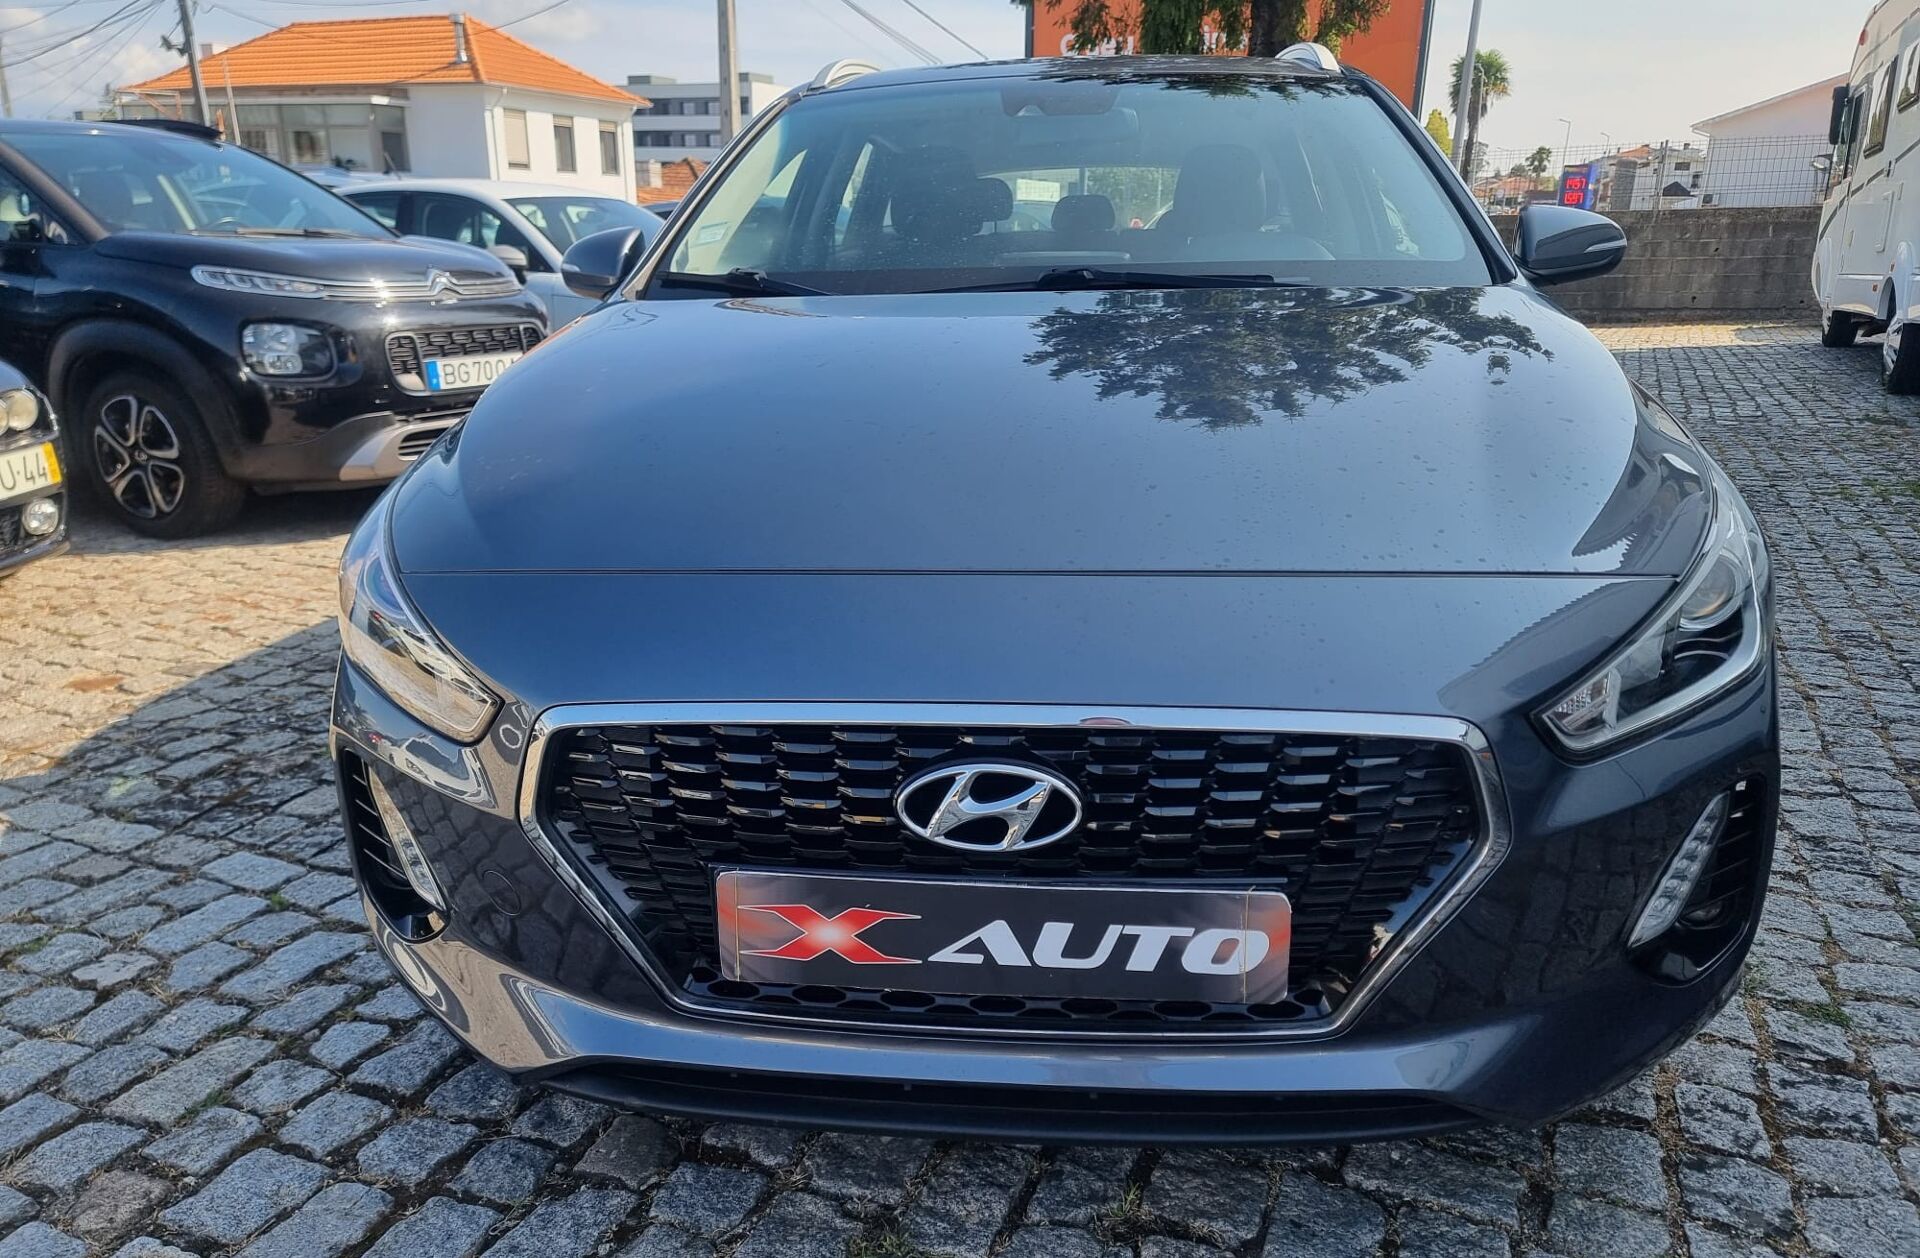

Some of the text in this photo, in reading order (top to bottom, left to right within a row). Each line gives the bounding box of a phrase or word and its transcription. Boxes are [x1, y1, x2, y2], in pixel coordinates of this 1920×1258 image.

[443, 359, 514, 385] BG700
[736, 903, 1271, 974] X AUTO
